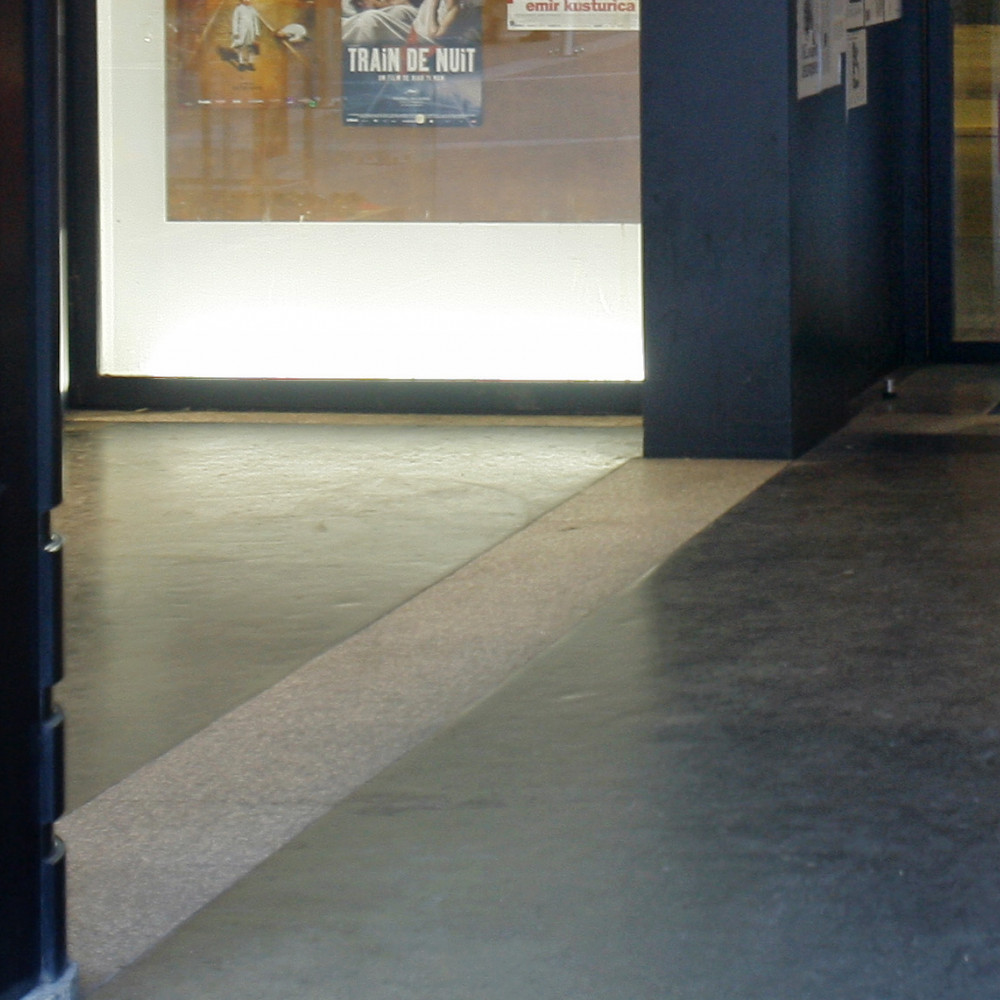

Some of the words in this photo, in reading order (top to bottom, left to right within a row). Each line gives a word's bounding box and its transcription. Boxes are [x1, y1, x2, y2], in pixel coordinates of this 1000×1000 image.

[526, 0, 559, 12] emir
[564, 0, 636, 12] kusturica
[406, 47, 430, 73] DE
